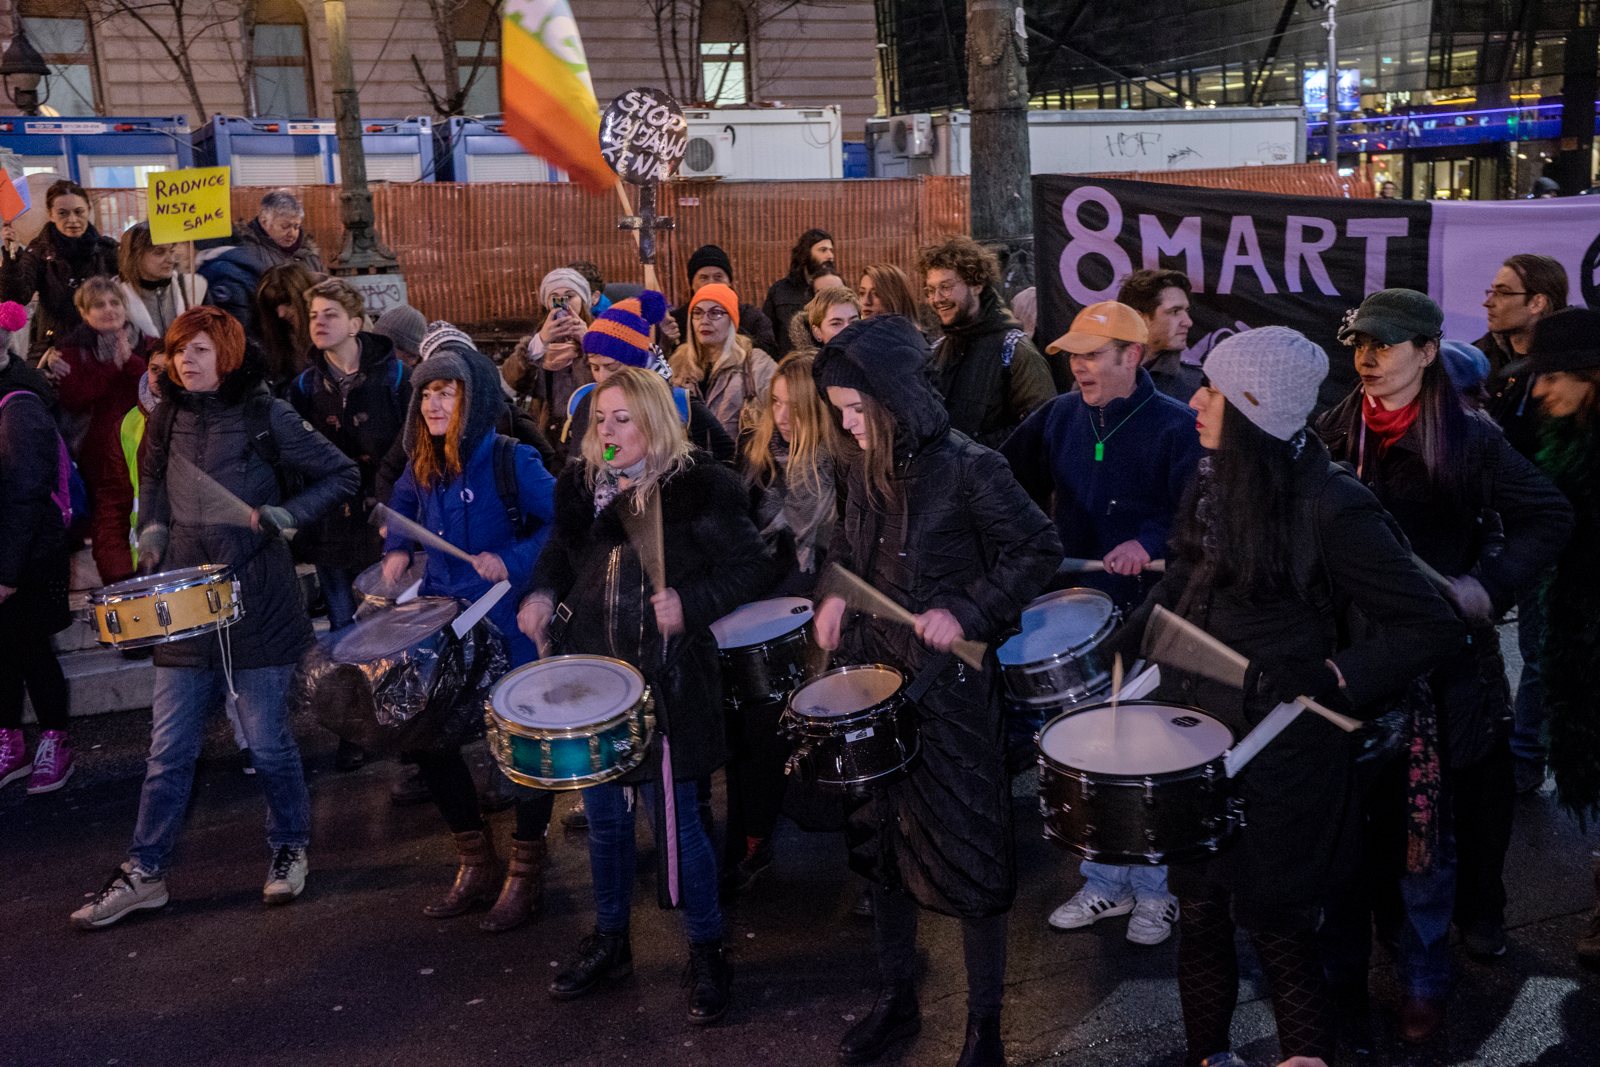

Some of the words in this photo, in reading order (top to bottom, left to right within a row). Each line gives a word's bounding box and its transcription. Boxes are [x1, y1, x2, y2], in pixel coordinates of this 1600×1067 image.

[617, 91, 688, 132] STOP
[155, 174, 225, 200] RADNICE
[156, 202, 197, 216] NISTE
[183, 207, 225, 232] SAME
[1059, 186, 1133, 307] 8
[1138, 214, 1410, 299] MART
